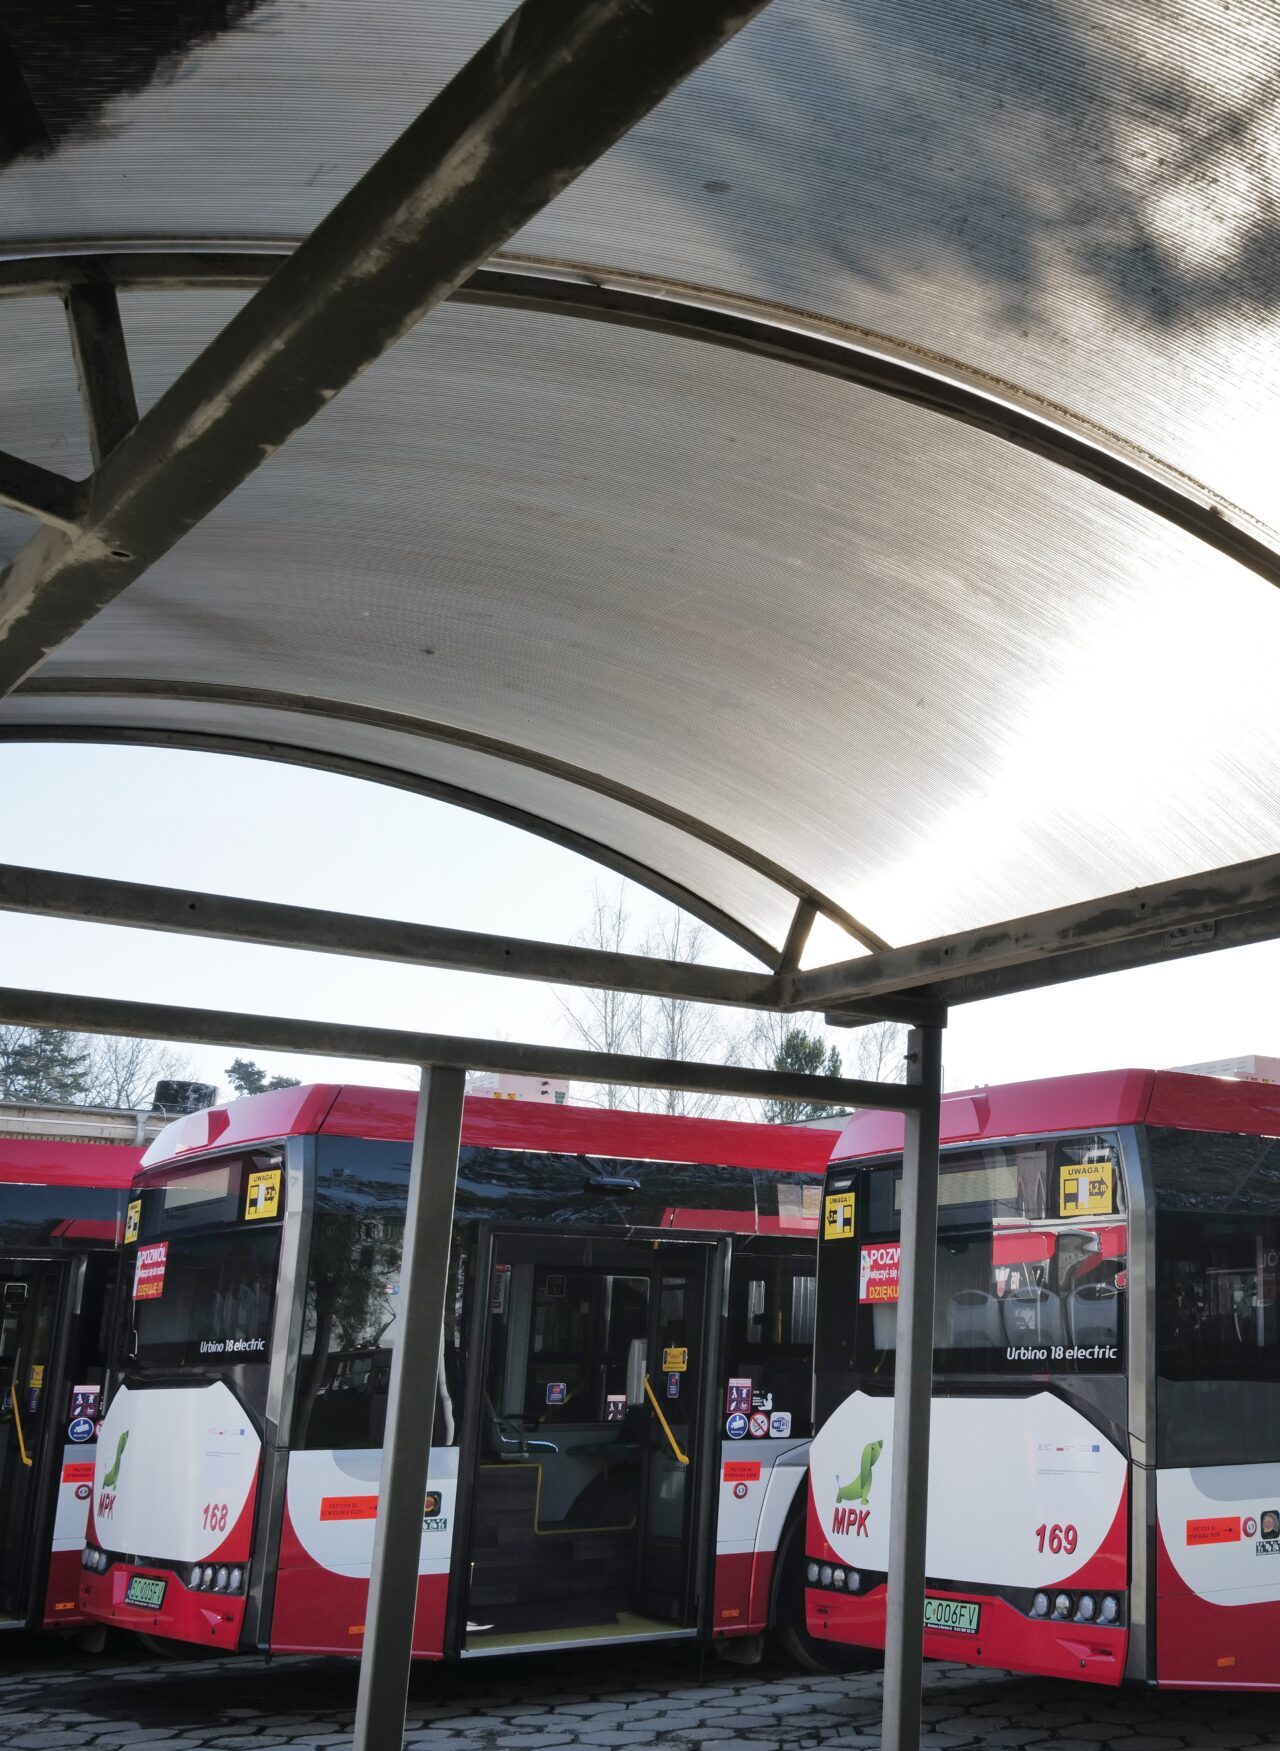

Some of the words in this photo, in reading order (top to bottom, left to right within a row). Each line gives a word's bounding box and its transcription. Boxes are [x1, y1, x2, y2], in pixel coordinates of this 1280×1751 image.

[1068, 1166, 1099, 1175] UWAGA
[253, 1174, 273, 1183] UWAGA
[1090, 1182, 1100, 1194] 1,2
[1100, 1185, 1107, 1193] m
[829, 1197, 848, 1205] UWAGA
[140, 1243, 167, 1265] POZWÓL
[870, 1248, 901, 1265] POZW
[889, 1266, 897, 1280] się
[869, 1286, 899, 1301] DZIĘKU
[200, 1341, 224, 1353] Urbino
[225, 1339, 234, 1352] 18
[234, 1338, 266, 1351] electric
[1006, 1346, 1047, 1360] Urbino
[1051, 1346, 1064, 1360] 18
[1065, 1345, 1117, 1359] electric
[98, 1492, 116, 1520] MPK
[203, 1503, 229, 1532] 168
[832, 1507, 871, 1538] MPK
[1035, 1523, 1078, 1555] 169
[924, 1601, 933, 1621] C
[936, 1602, 977, 1627] 006FV
